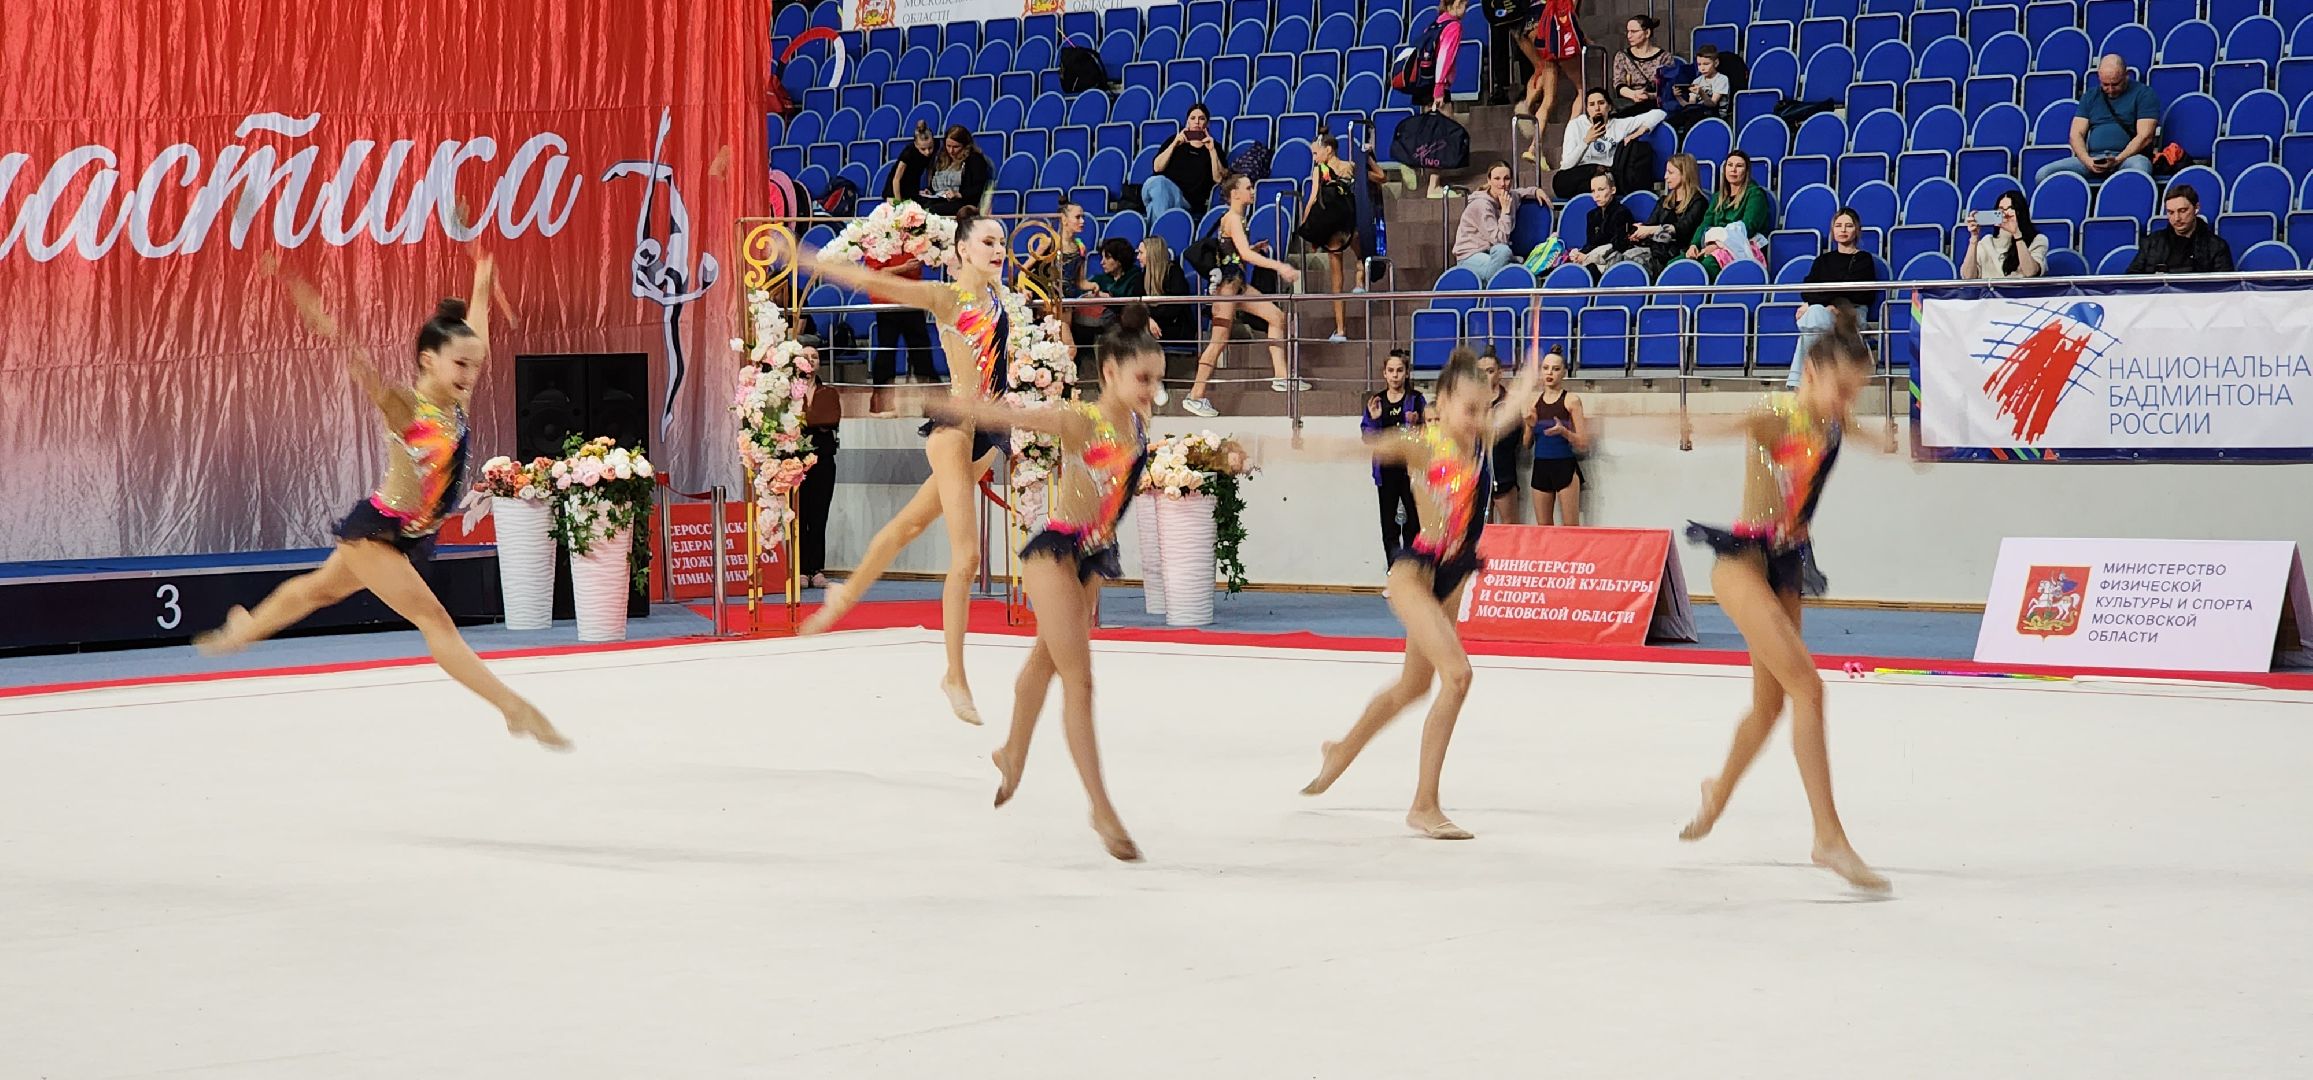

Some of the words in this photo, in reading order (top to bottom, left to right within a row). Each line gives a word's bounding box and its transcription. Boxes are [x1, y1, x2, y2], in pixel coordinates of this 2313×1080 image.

[2109, 354, 2312, 382] НАЦИОНАЛЬНА
[2110, 383, 2294, 411] БАДМИНТОНА
[2110, 412, 2211, 435] РОССИИ
[1486, 558, 1596, 574] МИНИСТЕРСТВО
[2102, 562, 2227, 576] МИНИСТЕРСТВО
[1483, 574, 1576, 590] ФИЗИЧЕСКОЙ
[1578, 578, 1654, 593] КУЛЬТУРЫ
[2099, 579, 2202, 593] ФИЗИЧЕСКОЙ
[1479, 590, 1492, 601] И
[1493, 590, 1546, 604] СПОРТА
[2095, 596, 2173, 609] КУЛЬТУРЫ
[2177, 598, 2188, 609] И
[2192, 599, 2253, 611] СПОРТА
[156, 584, 182, 630] 3
[1475, 605, 1569, 621] МОСКОВСКОЙ
[1571, 608, 1636, 624] ОБЛАСТИ
[2091, 613, 2198, 627] МОСКОВСКОЙ
[2088, 630, 2159, 643] ОБЛАСТИ
